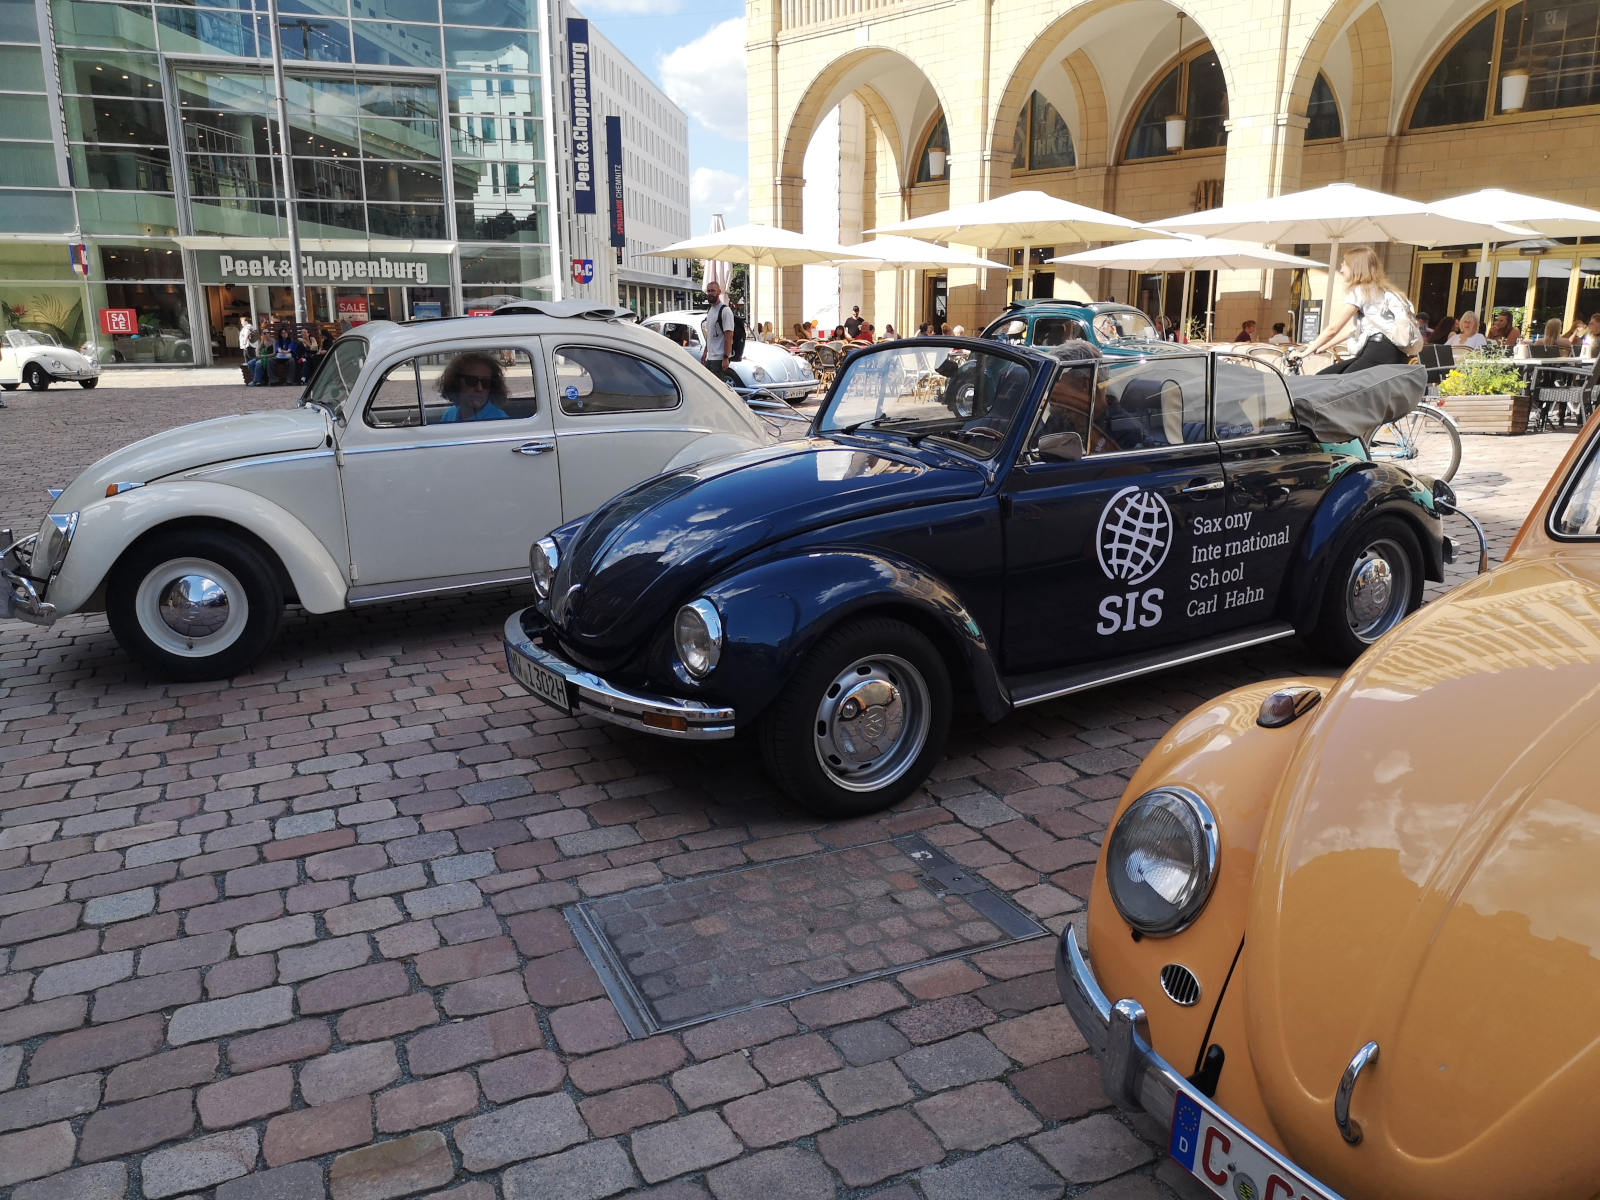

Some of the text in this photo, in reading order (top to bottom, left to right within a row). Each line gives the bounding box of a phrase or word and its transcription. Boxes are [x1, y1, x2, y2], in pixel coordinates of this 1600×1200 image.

[571, 42, 590, 191] Peek&Cloppenburg
[614, 164, 623, 199] CHEMNITZ
[615, 200, 624, 235] SPIELBANK
[574, 263, 593, 277] P&C
[111, 313, 126, 322] SA
[339, 303, 366, 312] SALE
[112, 321, 126, 330] LE
[1193, 511, 1252, 536] Saxony
[1191, 525, 1290, 564] International
[1189, 562, 1244, 591] School
[1096, 588, 1165, 636] SIS
[1186, 587, 1264, 618] Carl Hahn
[1178, 1136, 1188, 1153] D
[1202, 1126, 1231, 1186] C
